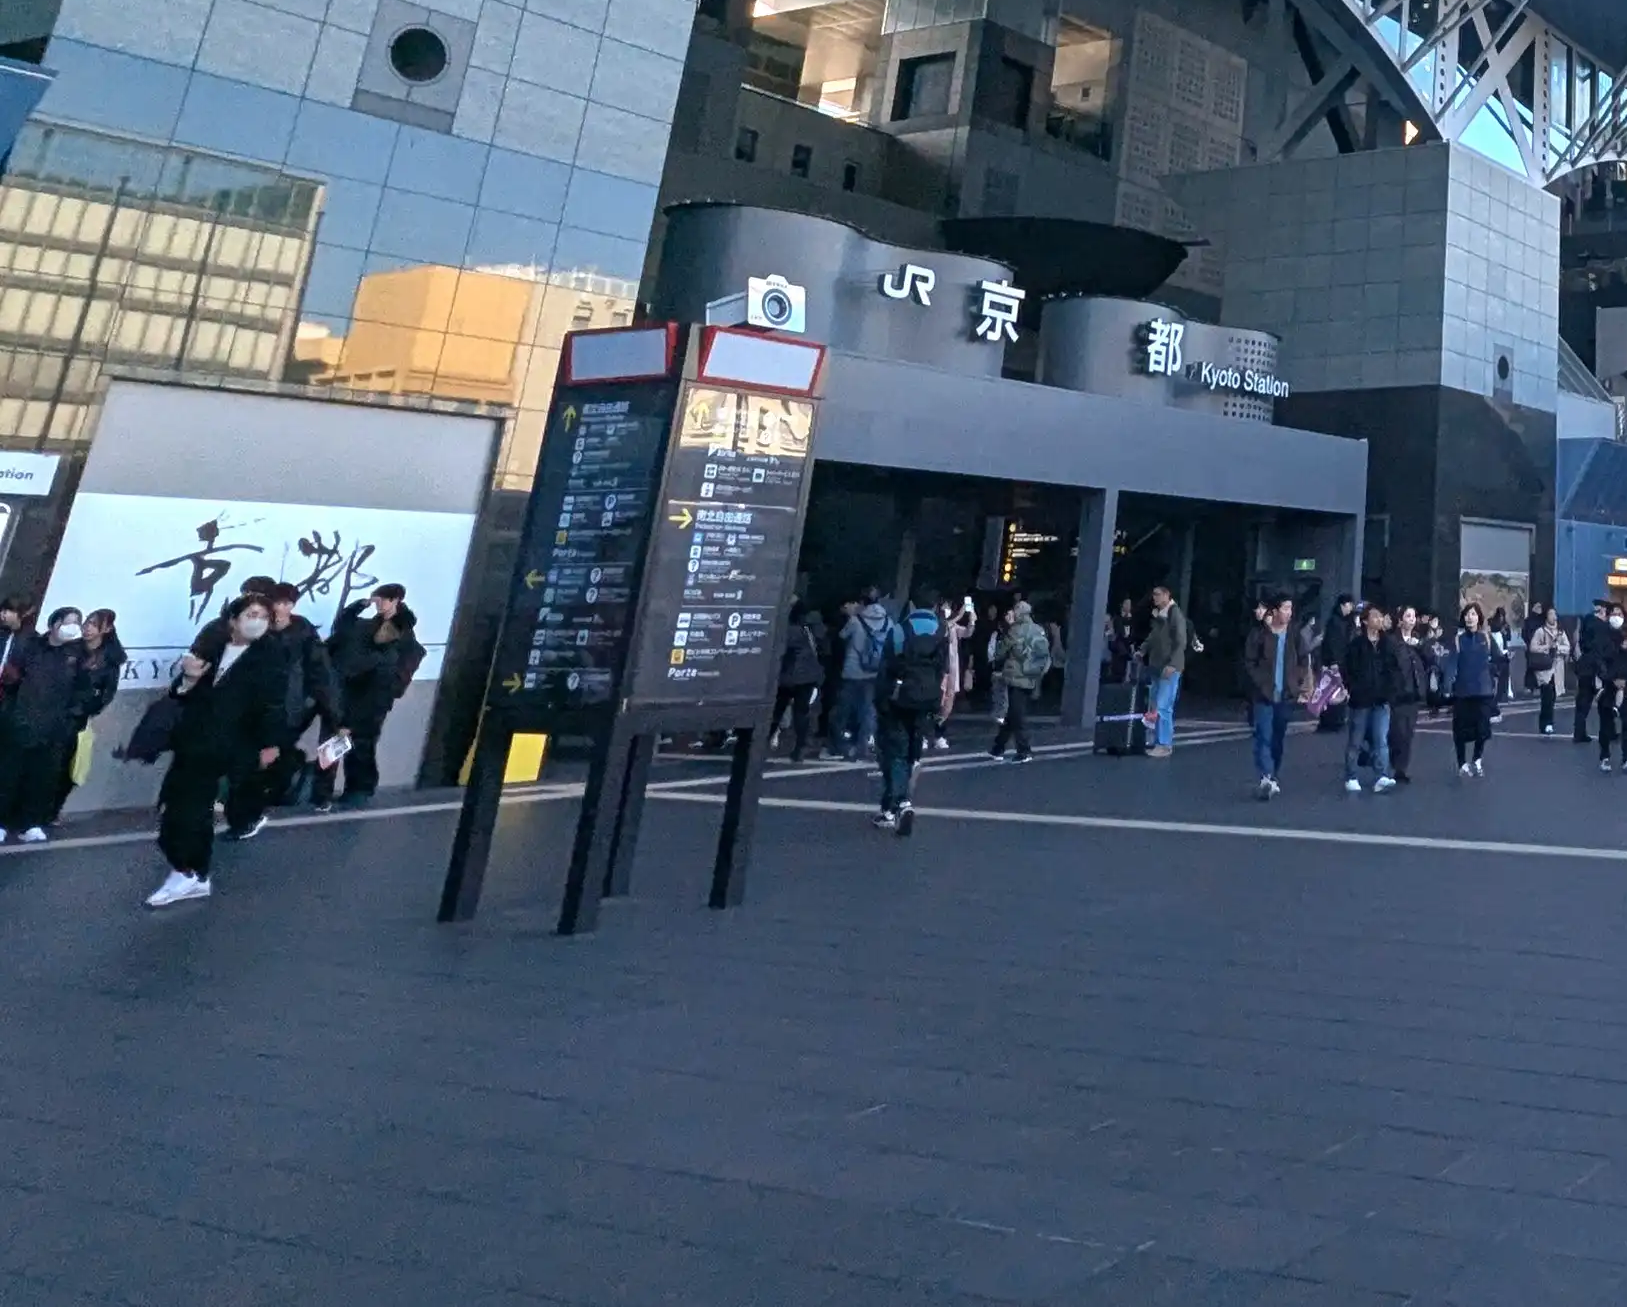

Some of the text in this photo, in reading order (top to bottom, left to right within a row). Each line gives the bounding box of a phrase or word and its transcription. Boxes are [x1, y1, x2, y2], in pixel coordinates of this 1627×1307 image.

[883, 264, 936, 306] JR
[1201, 362, 1289, 398] Kyoto Station
